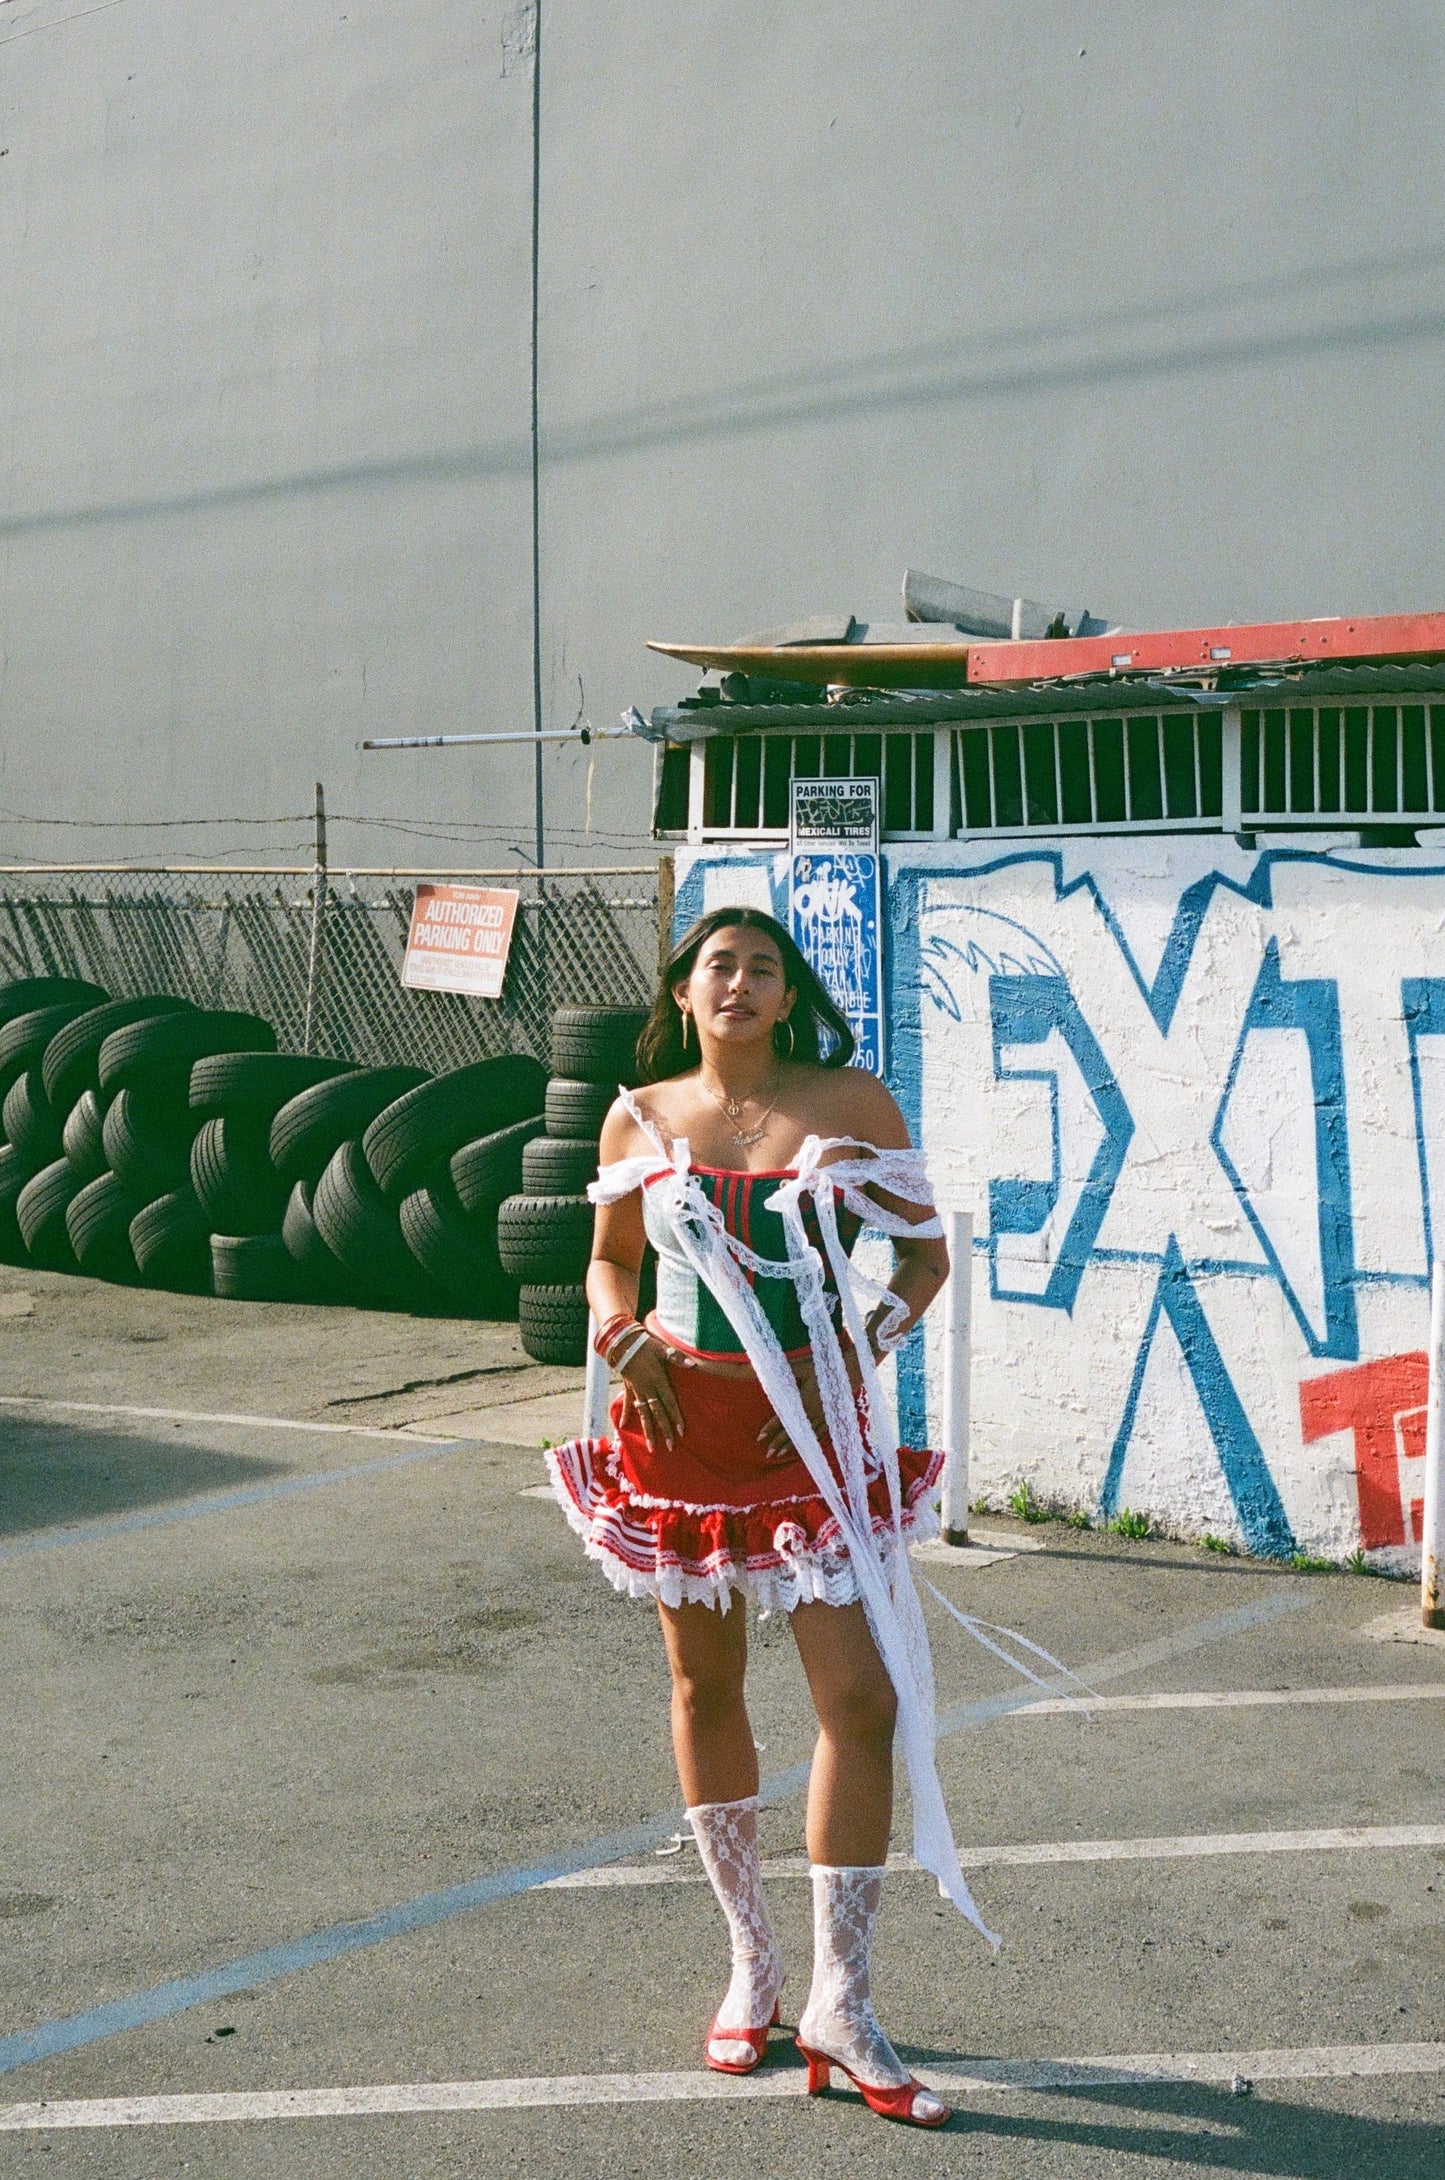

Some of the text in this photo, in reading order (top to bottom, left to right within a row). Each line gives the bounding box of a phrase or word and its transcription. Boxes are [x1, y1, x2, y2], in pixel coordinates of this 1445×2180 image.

[796, 785, 871, 797] PARKING FOR
[798, 826, 870, 836] MEXICALI TIRES
[425, 900, 504, 928] AUTHORIZED
[413, 922, 506, 955] PARKING ONLY
